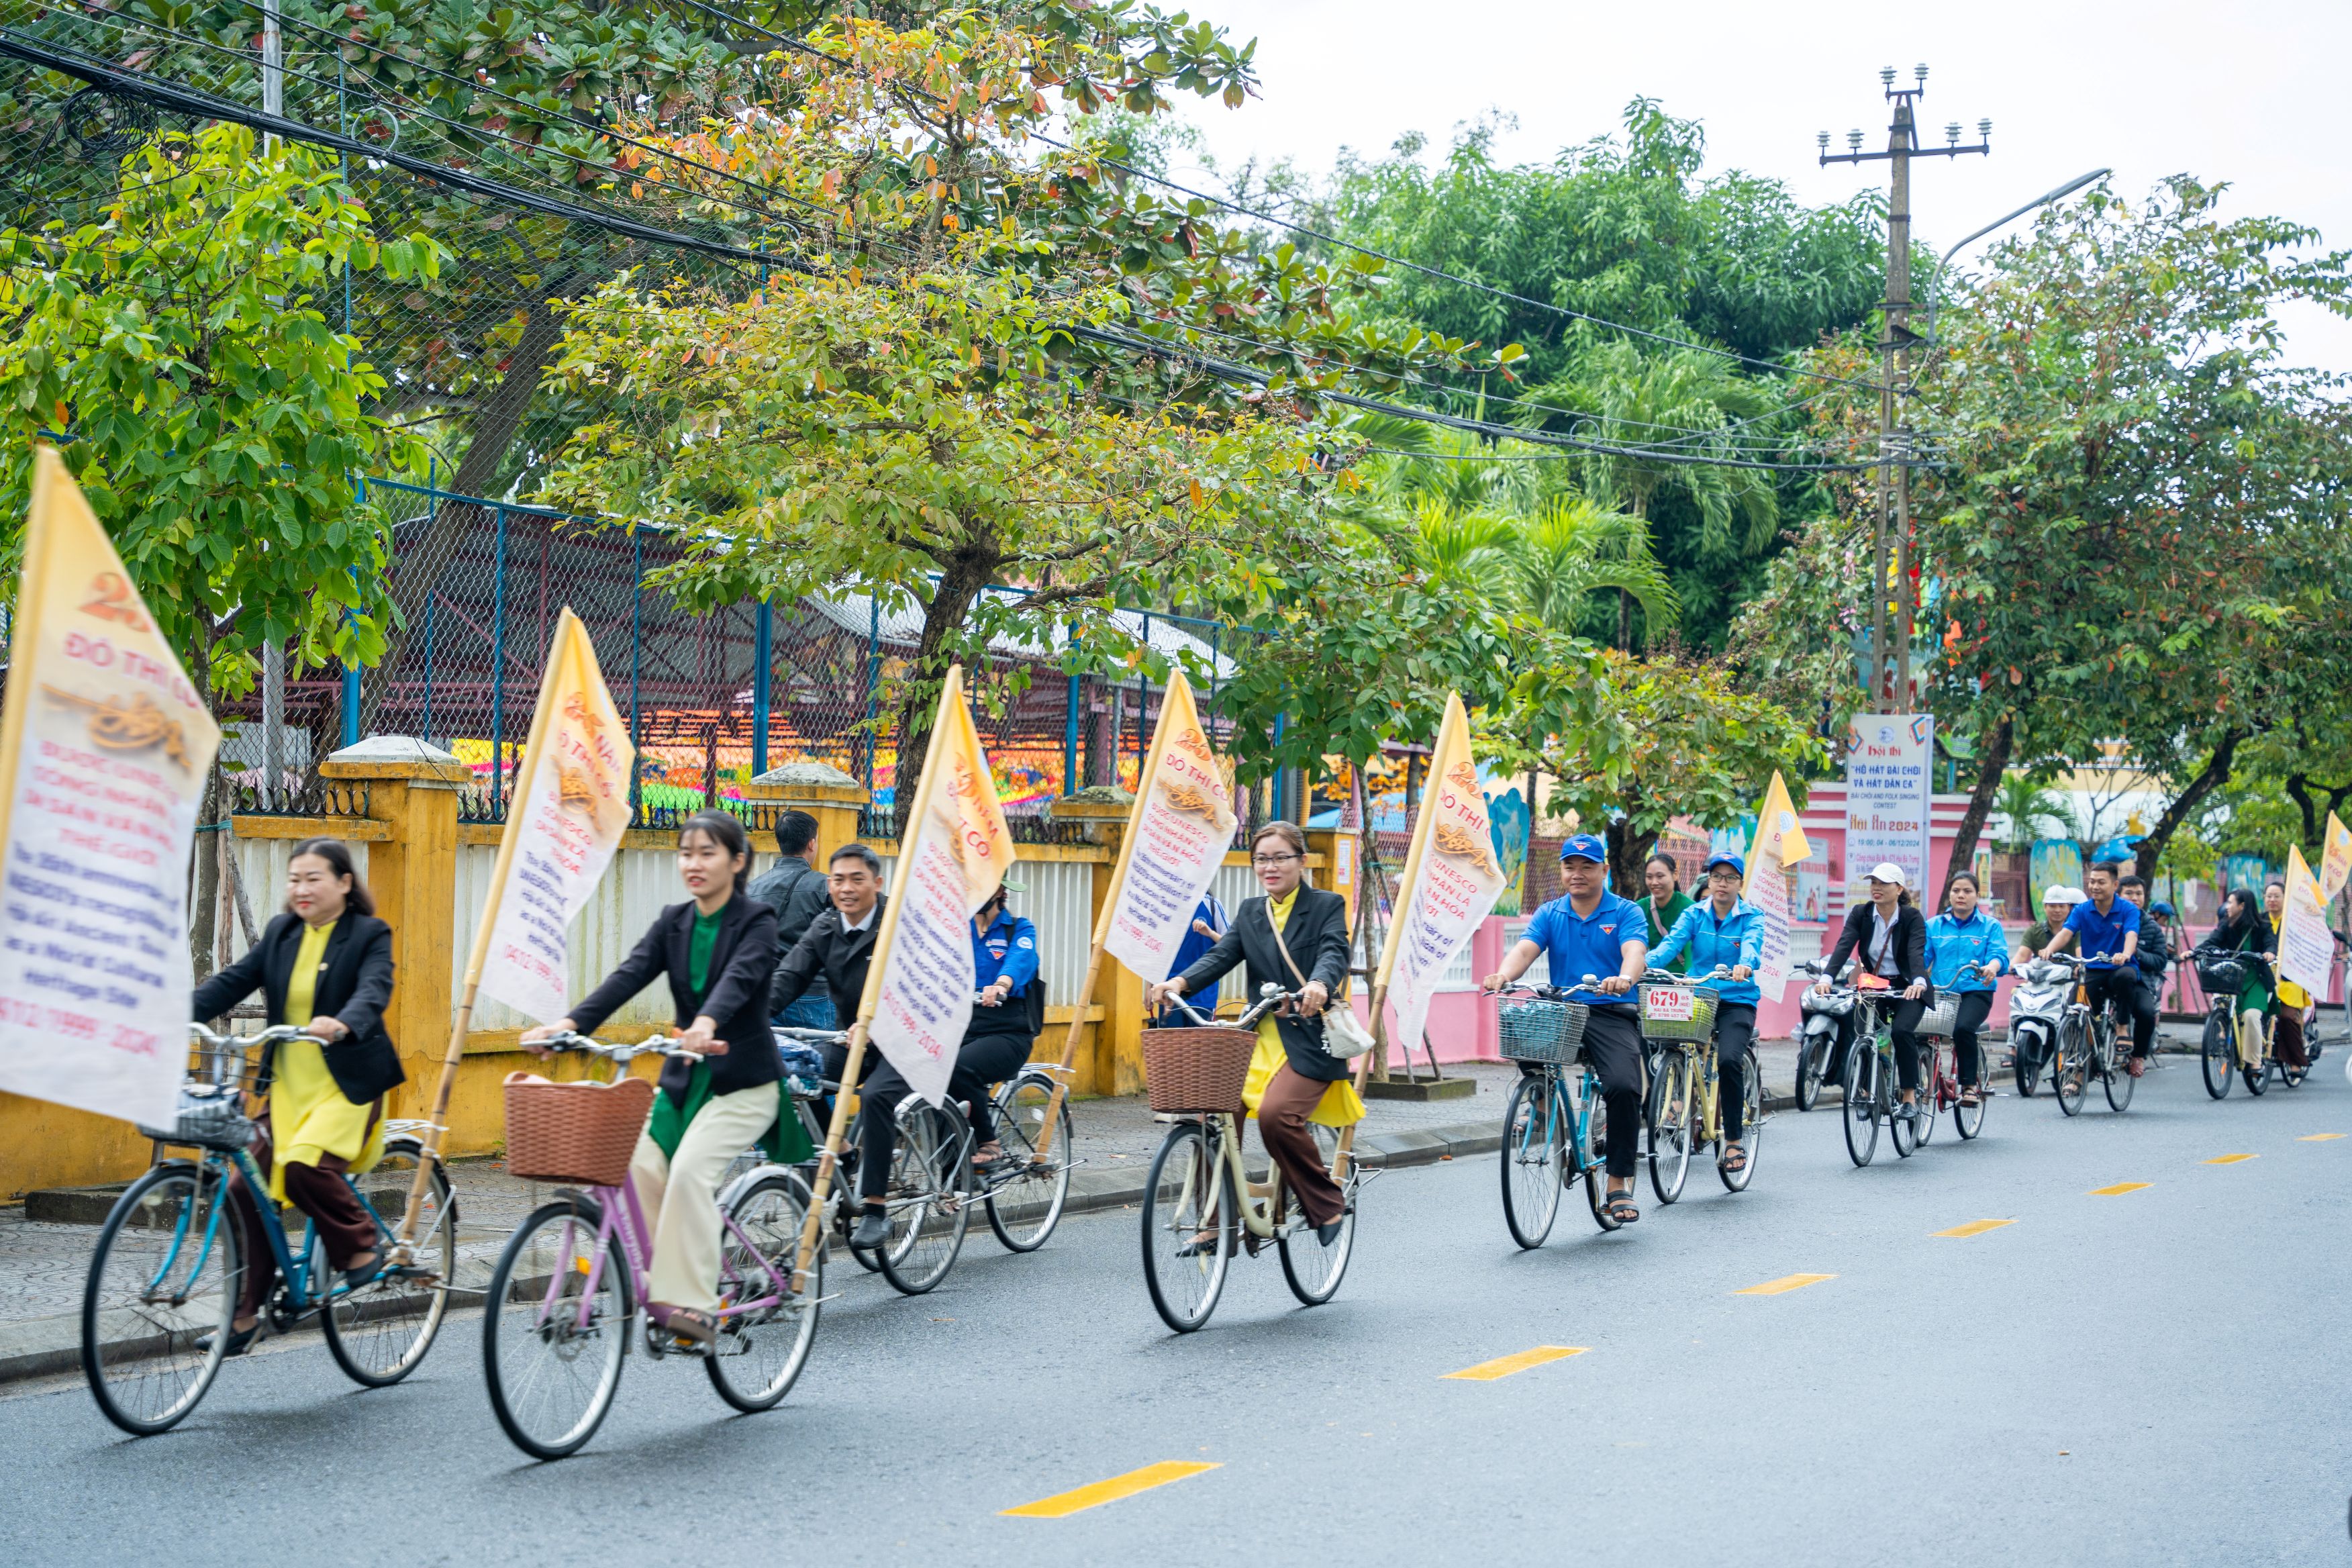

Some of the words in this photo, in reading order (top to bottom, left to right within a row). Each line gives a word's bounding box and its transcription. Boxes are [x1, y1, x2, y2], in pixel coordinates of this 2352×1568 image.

[1457, 803, 1484, 834] THỊ
[1889, 821, 1918, 831] 2024
[1764, 951, 1774, 961] Site
[1765, 942, 1785, 956] Cultural
[1650, 991, 1679, 1007] 679
